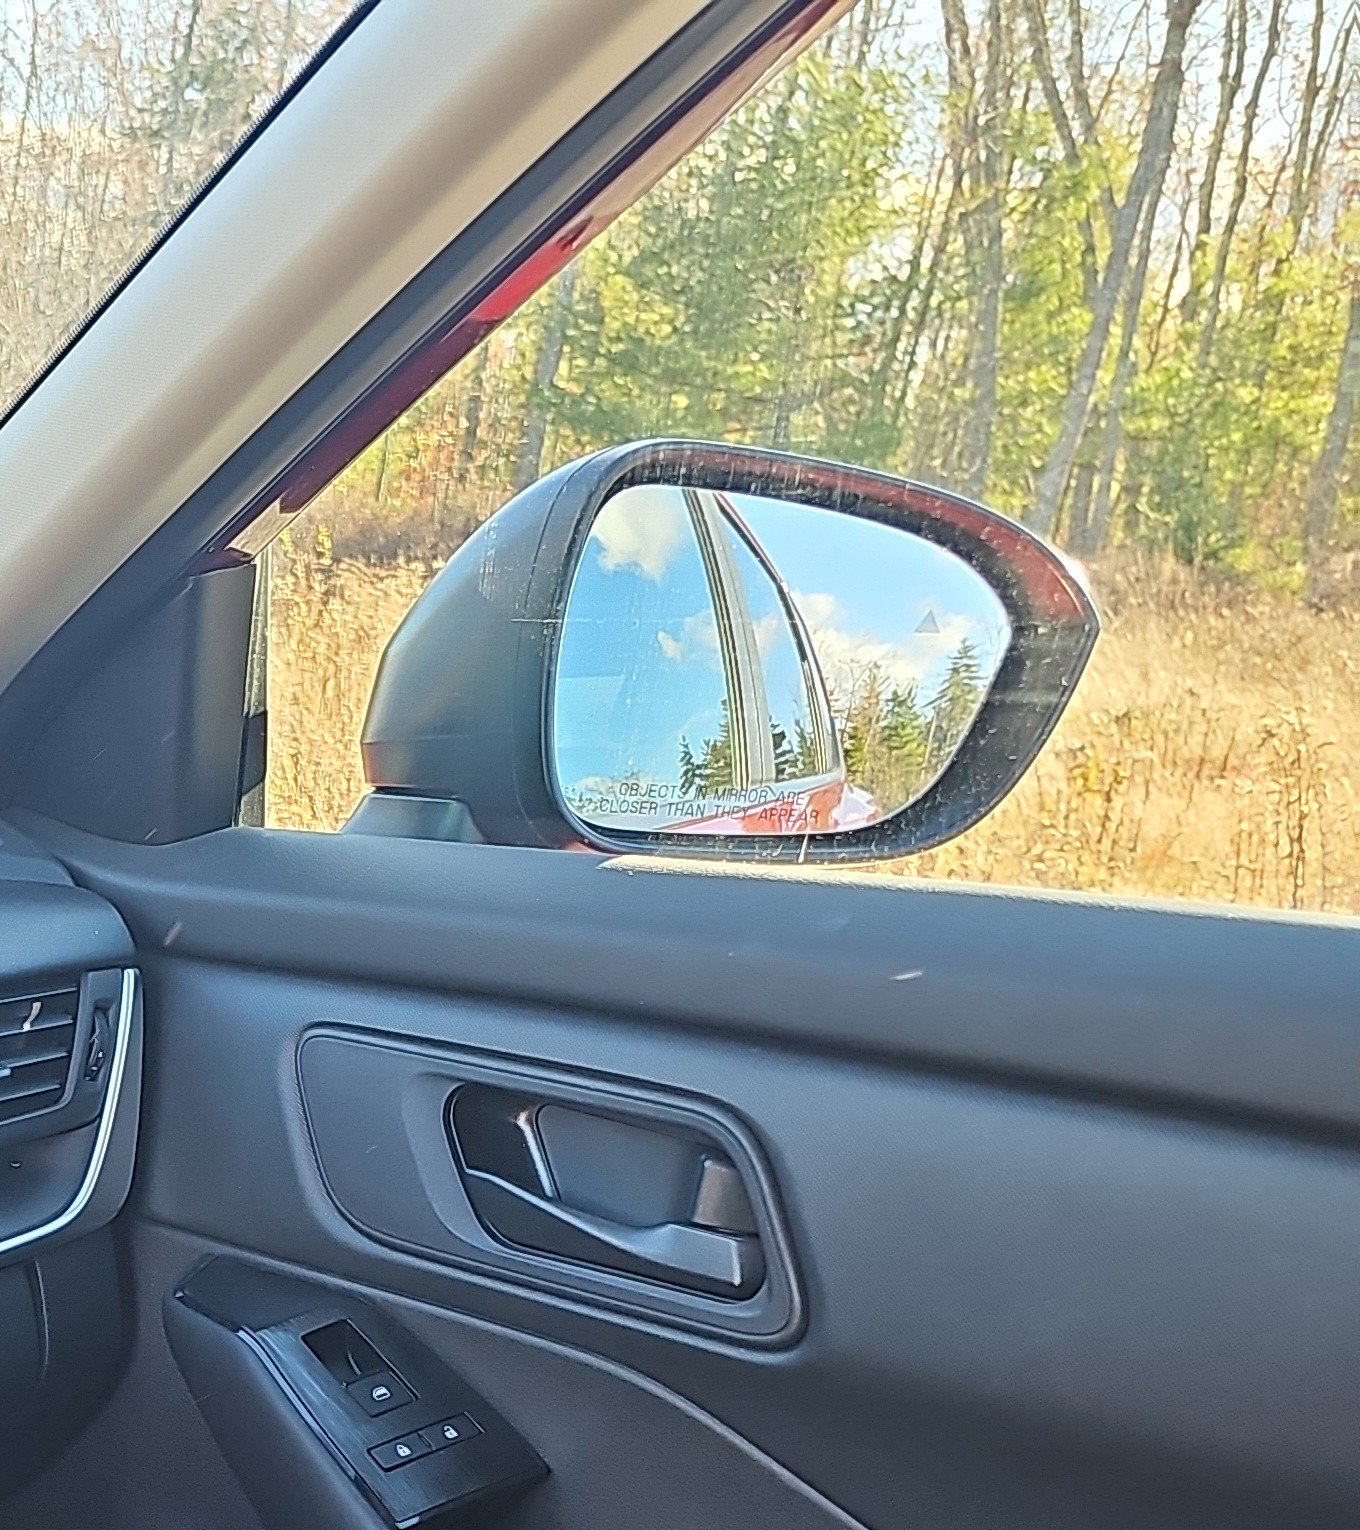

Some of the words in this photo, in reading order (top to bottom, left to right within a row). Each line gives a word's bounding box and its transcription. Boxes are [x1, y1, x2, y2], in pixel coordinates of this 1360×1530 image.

[618, 782, 687, 799] OBJECTS
[693, 787, 708, 800] IN
[713, 788, 768, 804] MIRROR
[774, 790, 805, 806] ARE
[599, 797, 658, 815] CLOSER
[667, 803, 706, 818] THAN
[714, 805, 749, 820] THEY
[757, 807, 819, 824] APPEAR
